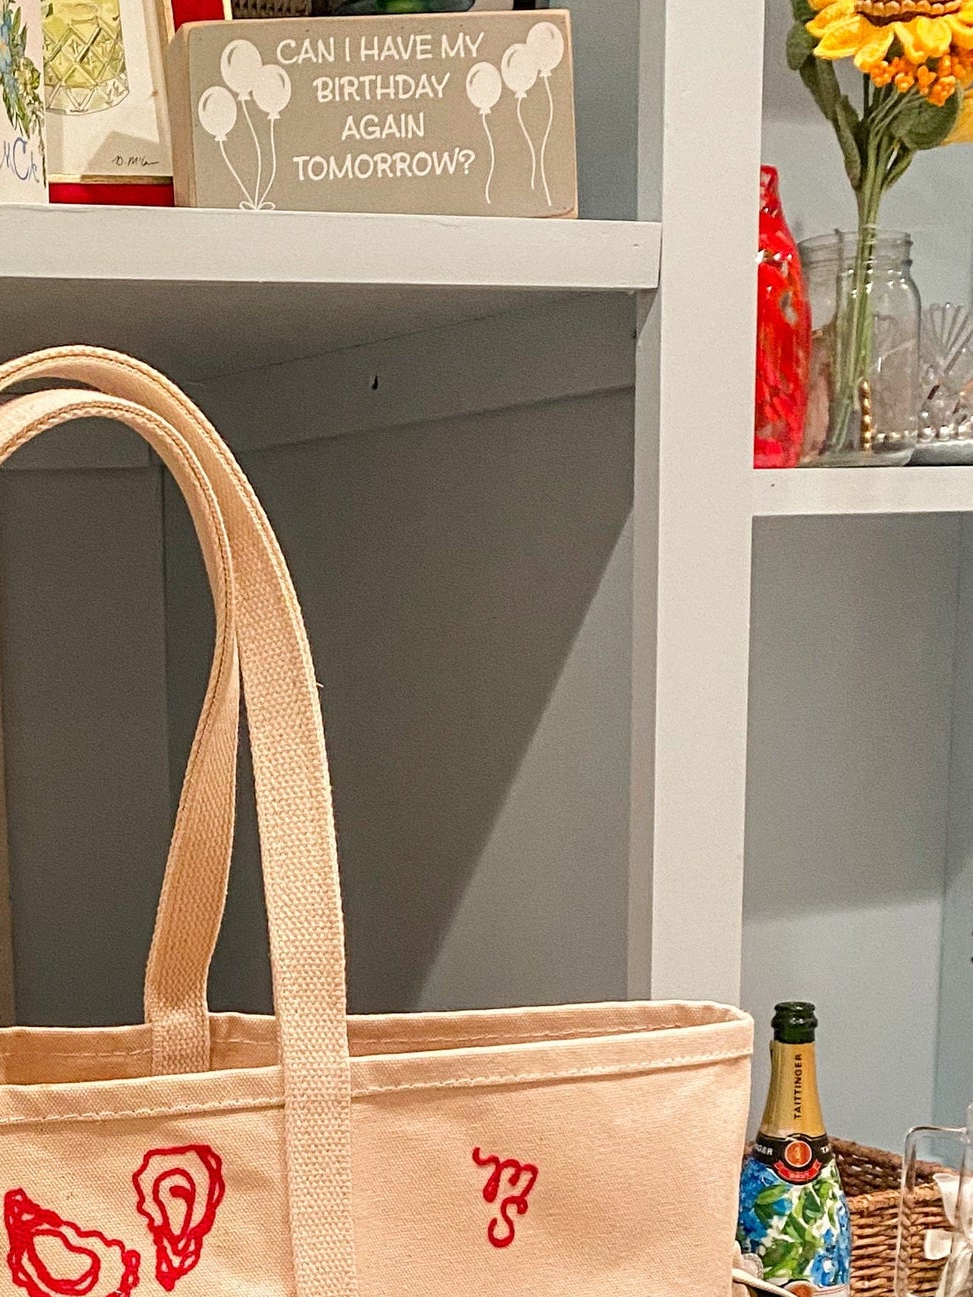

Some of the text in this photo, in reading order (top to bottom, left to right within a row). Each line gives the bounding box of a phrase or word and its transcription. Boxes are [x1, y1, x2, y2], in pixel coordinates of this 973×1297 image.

[276, 32, 485, 65] CAN I HAVE MY
[312, 72, 451, 103] BIRTHDAY
[341, 112, 425, 141] AGAIN
[292, 148, 476, 181] TOMORROW?
[793, 1053, 803, 1120] TAITTINGER
